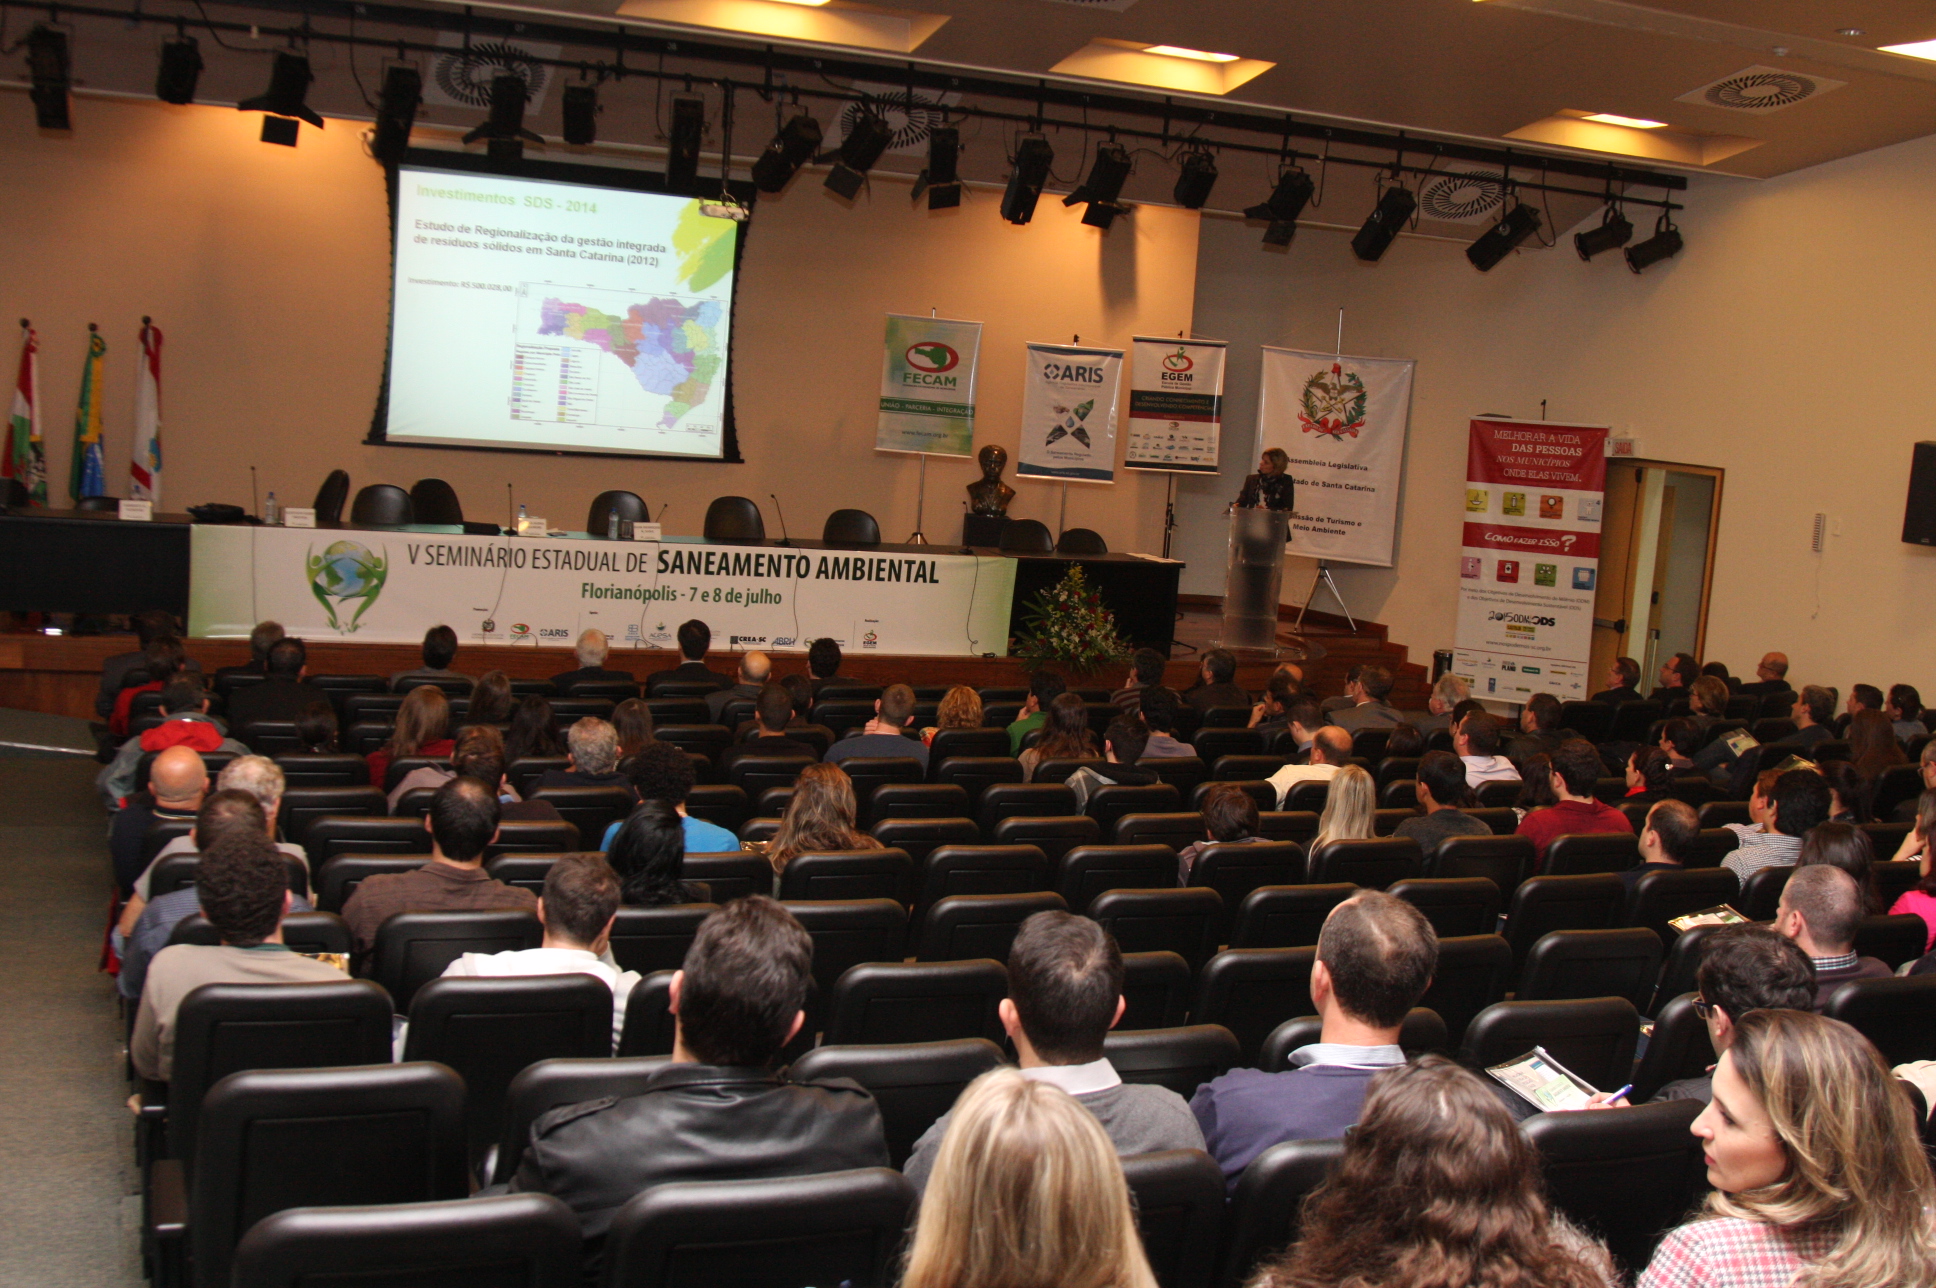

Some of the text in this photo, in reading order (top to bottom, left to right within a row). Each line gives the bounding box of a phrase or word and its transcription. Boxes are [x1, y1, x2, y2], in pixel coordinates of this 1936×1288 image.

[416, 184, 516, 206] Investimentos
[523, 195, 553, 209] SDS
[565, 200, 598, 213] 2014
[414, 219, 666, 253] Estudo de Regionalização da gestão integrada
[413, 234, 428, 244] de
[482, 240, 523, 253] sólidos
[525, 246, 543, 255] em
[545, 246, 576, 258] Santa
[579, 249, 624, 263] Catarina
[626, 254, 659, 268] (2012)
[903, 372, 957, 387] FECAM
[1060, 365, 1103, 383] ARIS
[1161, 372, 1193, 381] EGEM
[881, 401, 900, 409] UNIÃO
[905, 403, 931, 412] PARCERIA
[936, 406, 973, 415] INTEGRAÇÃO
[1494, 430, 1581, 444] MELHORAR A VIDA
[1512, 443, 1582, 456] DAS PESSOAS
[1328, 461, 1368, 471] Legislativa
[1496, 455, 1571, 468] NOS MUNICÍPIOS
[1503, 468, 1582, 482] ONDE ELAS VIVEM.
[1321, 481, 1342, 489] Santa
[1344, 483, 1375, 492] Catarina
[1326, 517, 1355, 526] Turismo
[1293, 523, 1346, 535] Meio Ambiente
[1485, 532, 1512, 543] COMO
[1514, 537, 1537, 545] FAZER
[407, 543, 939, 584] V SEMINÁRIO ESTADUAL DE SANEAMENTO AMBIENTAL
[581, 582, 677, 604] Florianópolis
[689, 586, 698, 602] 7
[701, 591, 709, 602] e
[712, 588, 722, 602] 8
[724, 587, 743, 603] de
[744, 587, 782, 608] julho
[547, 629, 568, 637] ARIS
